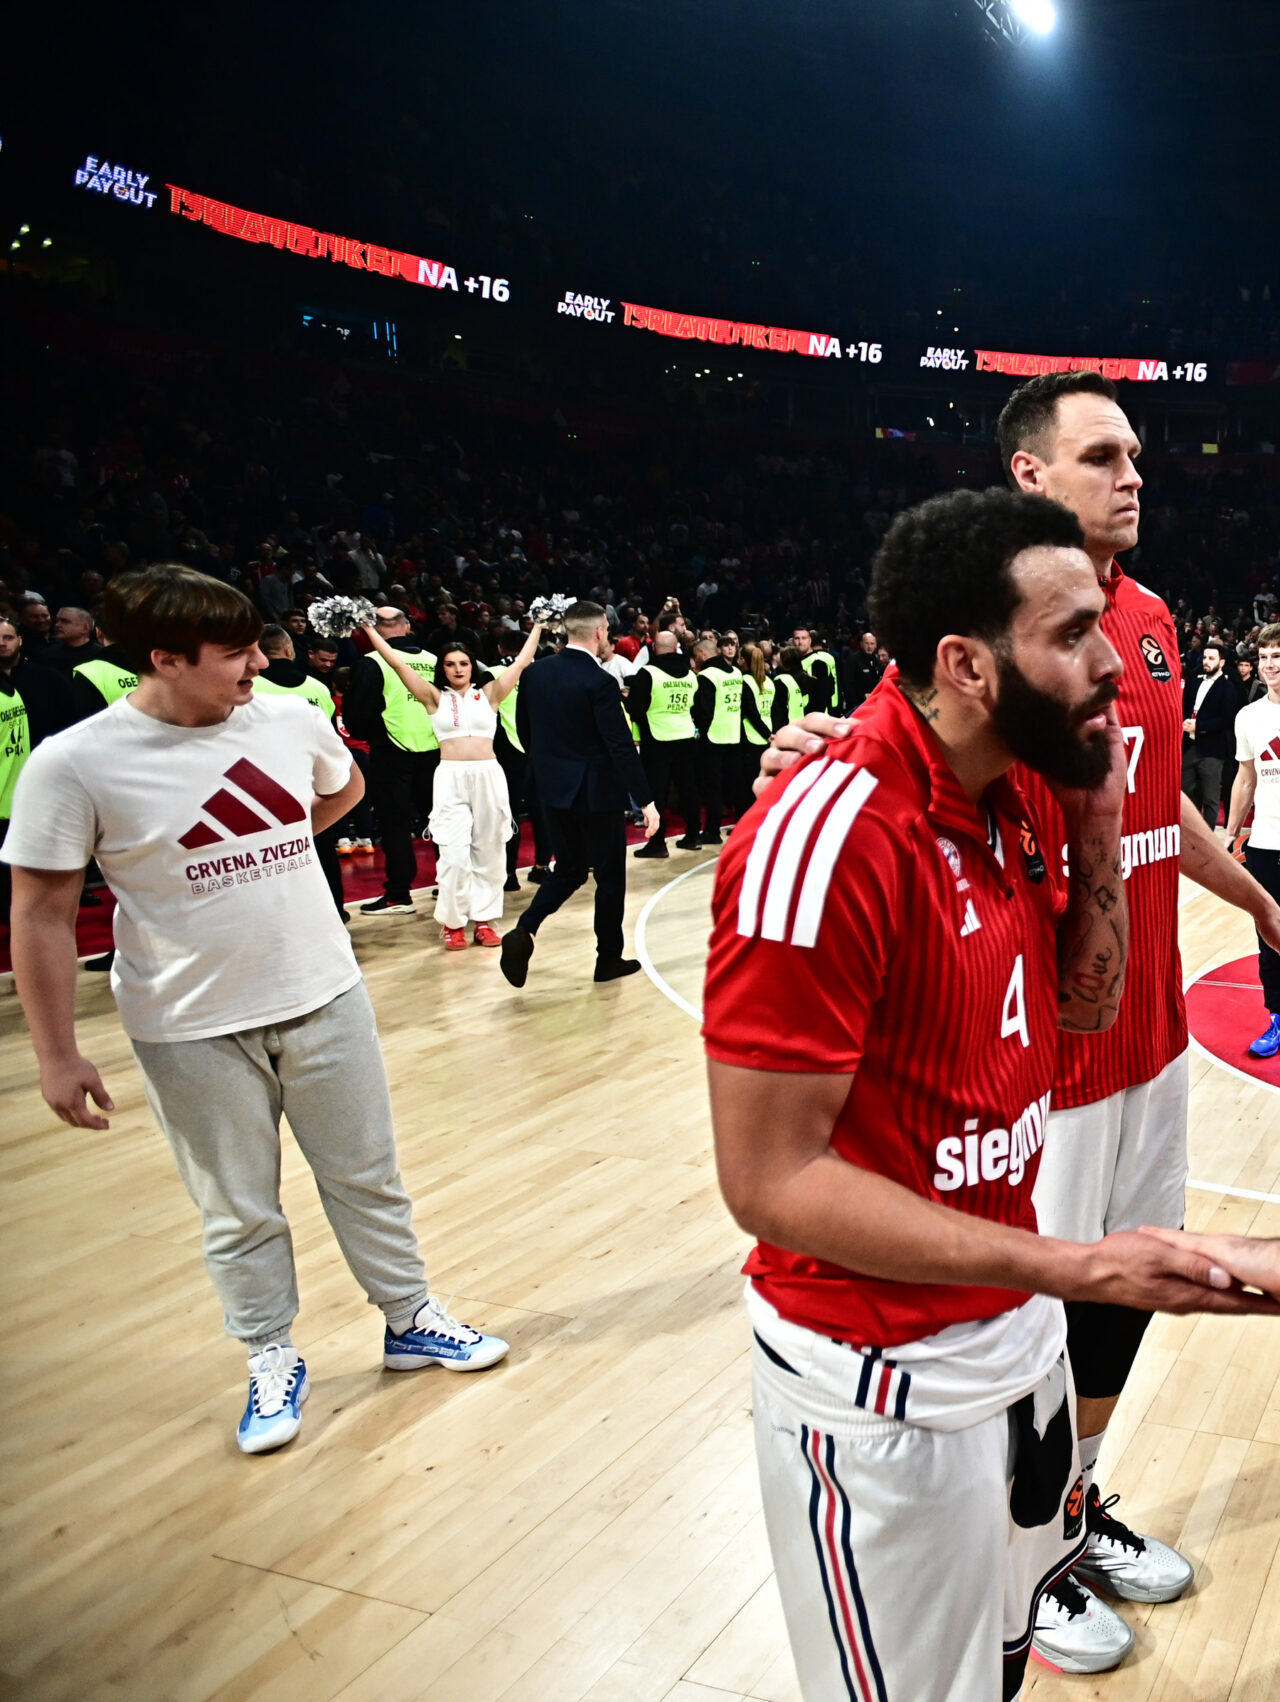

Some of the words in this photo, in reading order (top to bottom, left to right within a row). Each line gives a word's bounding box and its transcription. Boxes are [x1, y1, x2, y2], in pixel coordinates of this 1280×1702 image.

[75, 169, 158, 208] PAYOUT
[85, 156, 150, 190] EARLY
[417, 259, 459, 292] NA
[464, 275, 510, 302] +16
[557, 301, 615, 323] PAYOUT
[564, 291, 611, 311] EARLY
[808, 335, 842, 358] NA
[846, 341, 883, 364] +16
[919, 356, 969, 371] PAYOUT
[926, 346, 965, 361] EARLY
[1137, 361, 1169, 381] NA
[1172, 362, 1208, 382] +16
[185, 852, 257, 881] CRVENA
[259, 836, 311, 864] ZVEZDA
[191, 854, 312, 894] BASKETBALL
[1000, 953, 1030, 1048] 4
